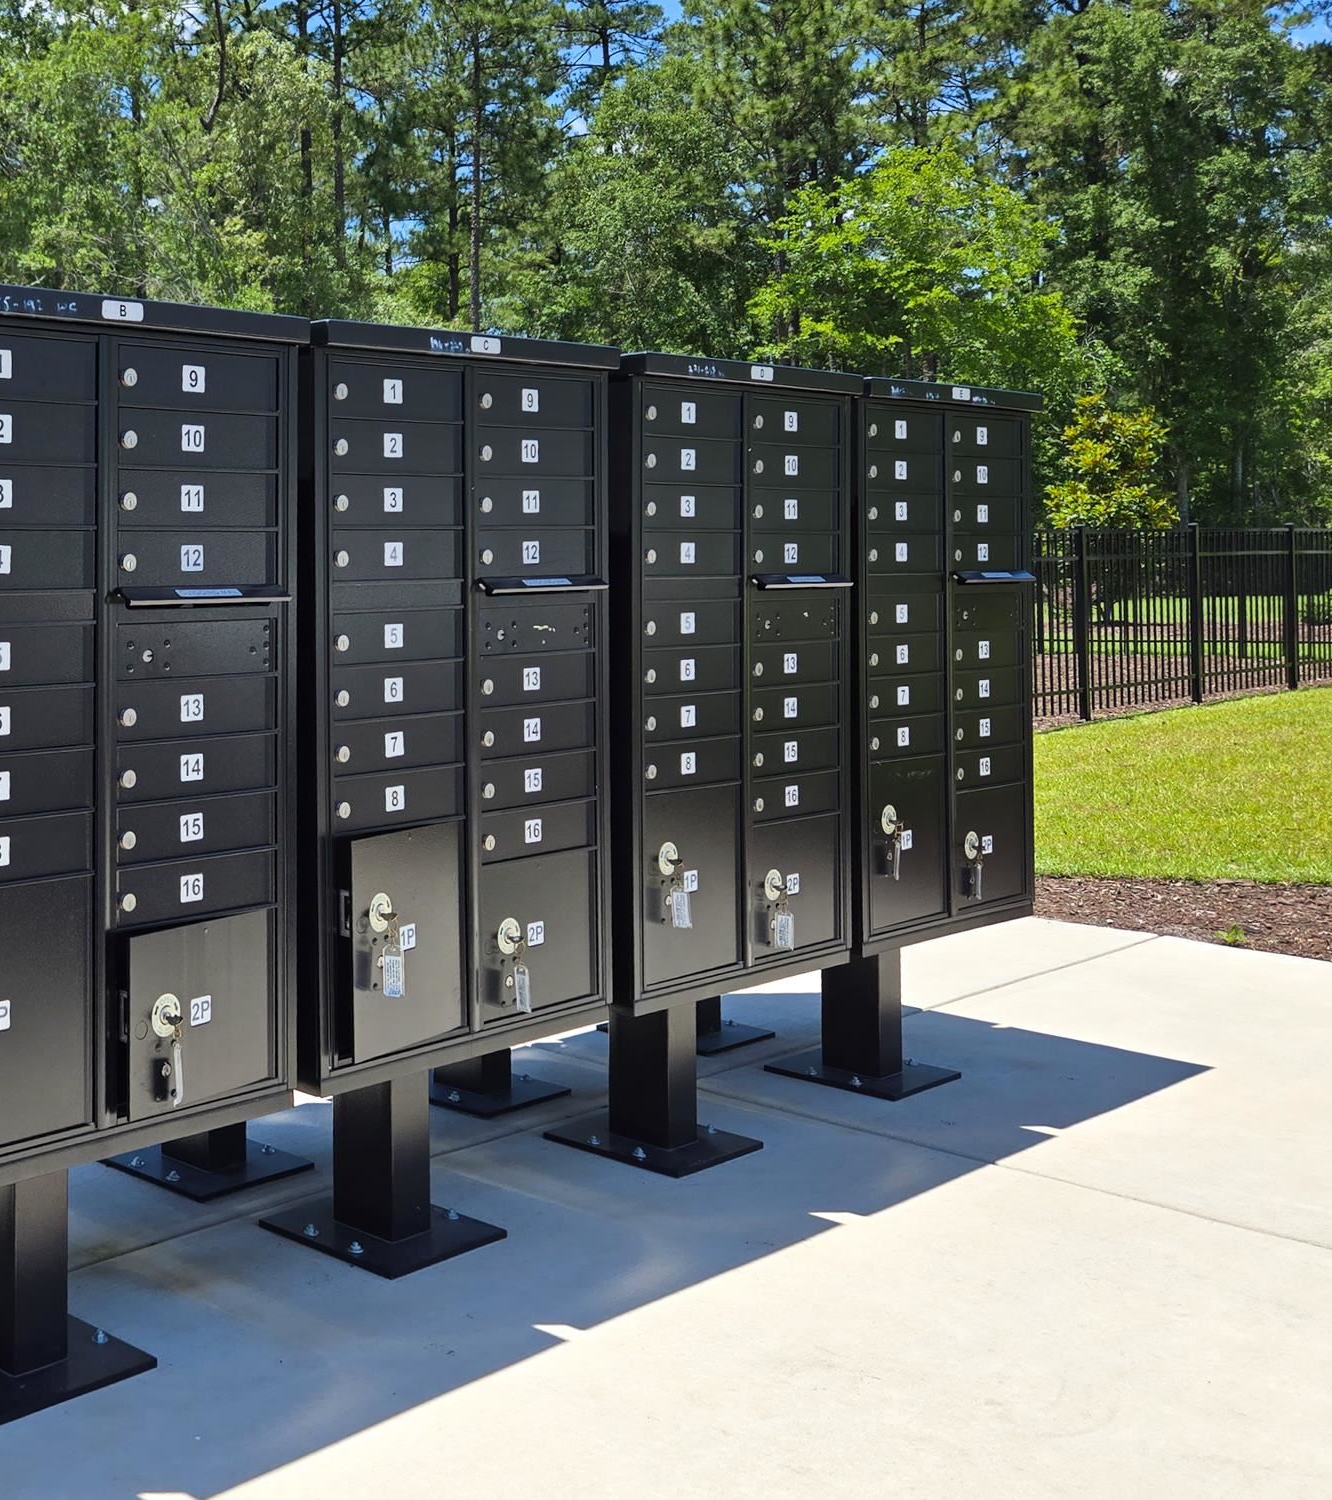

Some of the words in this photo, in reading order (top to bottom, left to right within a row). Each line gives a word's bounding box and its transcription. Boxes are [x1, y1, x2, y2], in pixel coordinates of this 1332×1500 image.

[119, 304, 127, 318] B
[483, 339, 490, 352] C
[188, 369, 199, 388] 9
[390, 383, 397, 400] 1
[526, 392, 534, 409] 9
[686, 405, 692, 421] 1
[788, 414, 794, 429] 9
[184, 428, 202, 448] 10
[899, 423, 904, 437] 1
[389, 437, 398, 454] 2
[523, 443, 537, 459] 10
[685, 452, 692, 467] 2
[786, 458, 797, 473] 10
[898, 463, 904, 477] 2
[978, 468, 987, 481] 10
[184, 489, 201, 508] 11
[389, 491, 398, 509] 3
[525, 494, 538, 510] 11
[684, 498, 692, 514] 3
[786, 502, 797, 517] 11
[978, 507, 987, 521] 11
[183, 548, 202, 568] 12
[389, 545, 398, 562] 4
[524, 544, 538, 561] 12
[684, 545, 692, 561] 4
[786, 546, 797, 561] 12
[979, 546, 987, 559] 12
[899, 606, 906, 621] 5
[684, 615, 692, 631] 5
[389, 627, 398, 645] 5
[979, 643, 989, 656] 13
[684, 662, 691, 678] 6
[785, 656, 796, 671] 13
[525, 670, 539, 687] 13
[389, 681, 398, 699] 6
[900, 689, 906, 702] 7
[980, 682, 989, 695] 14
[183, 698, 202, 718] 13
[684, 708, 692, 724] 7
[785, 701, 796, 715] 14
[525, 721, 539, 738] 14
[980, 721, 990, 734] 15
[390, 735, 399, 753] 7
[785, 744, 797, 759] 15
[182, 757, 202, 777] 14
[685, 755, 692, 771] 8
[980, 759, 989, 773] 16
[526, 772, 540, 789] 15
[391, 790, 399, 807] 8
[786, 788, 797, 803] 16
[182, 817, 201, 837] 15
[526, 822, 540, 839] 16
[182, 877, 201, 898] 16
[684, 873, 697, 890] 1P
[787, 876, 799, 892] 2P
[400, 927, 415, 947] 1P
[528, 924, 544, 943] 2P
[191, 999, 210, 1022] 2P
